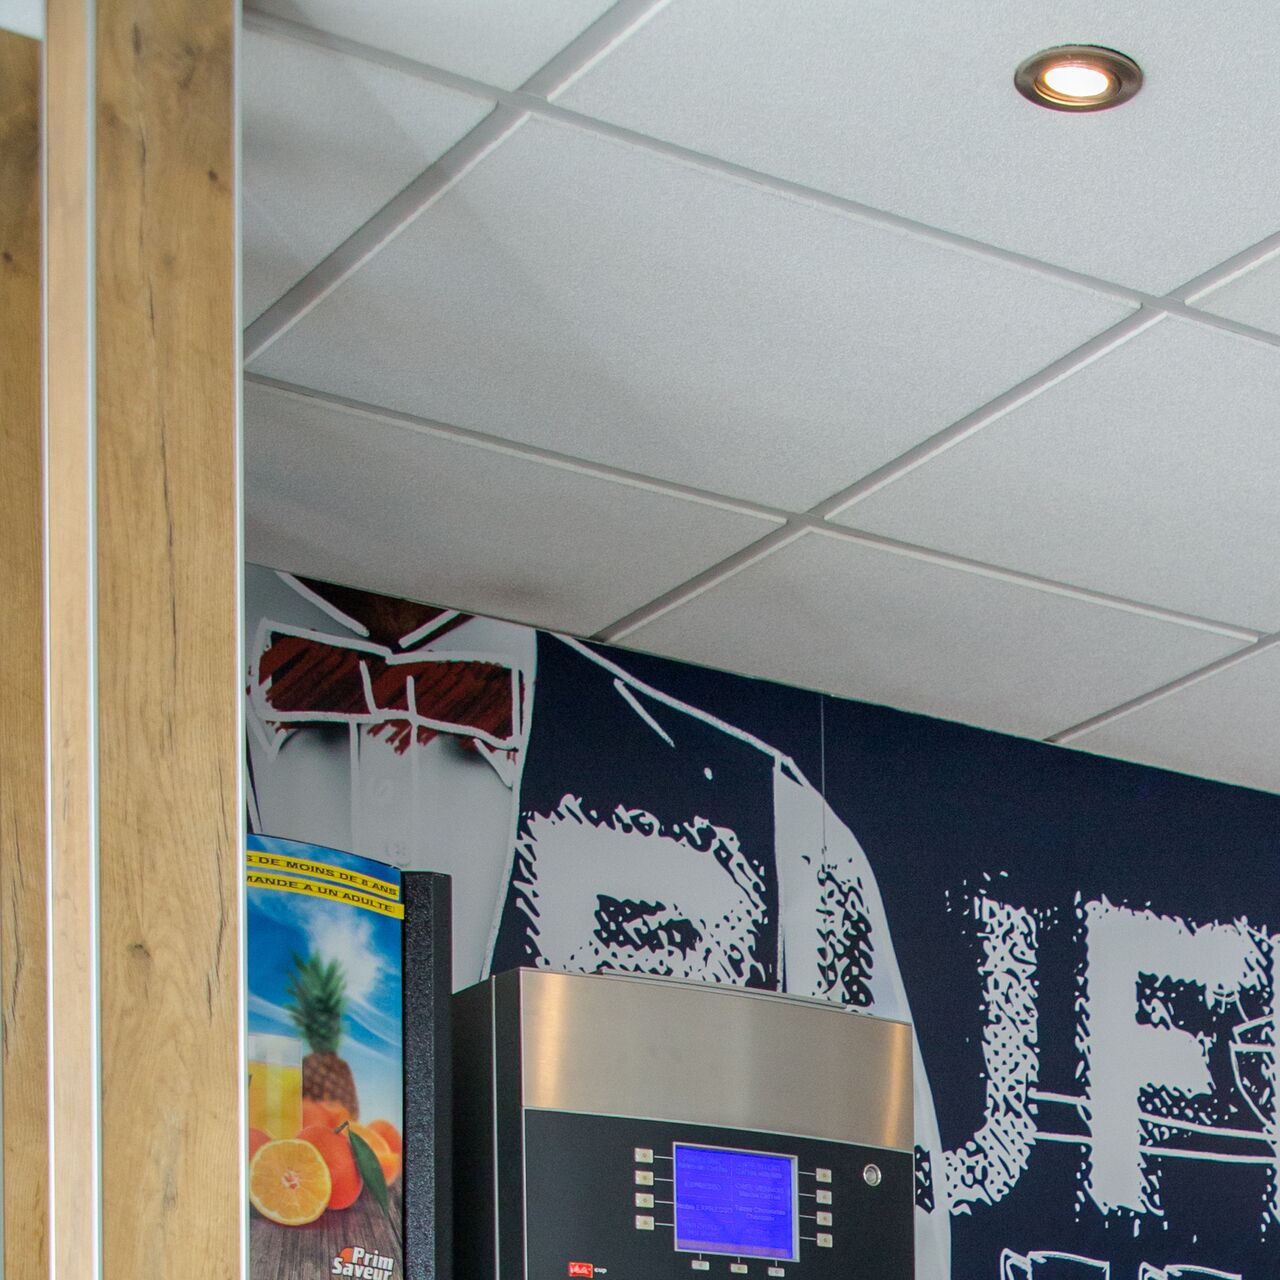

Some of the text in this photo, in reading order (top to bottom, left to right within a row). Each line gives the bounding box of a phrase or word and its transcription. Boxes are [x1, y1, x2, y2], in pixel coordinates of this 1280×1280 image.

[259, 856, 281, 867] DE
[286, 861, 335, 877] MOINS
[339, 872, 358, 883] DE
[372, 882, 397, 896] ANS
[318, 887, 338, 897] UN
[342, 892, 394, 913] ADULTE
[352, 1246, 394, 1271] Prim
